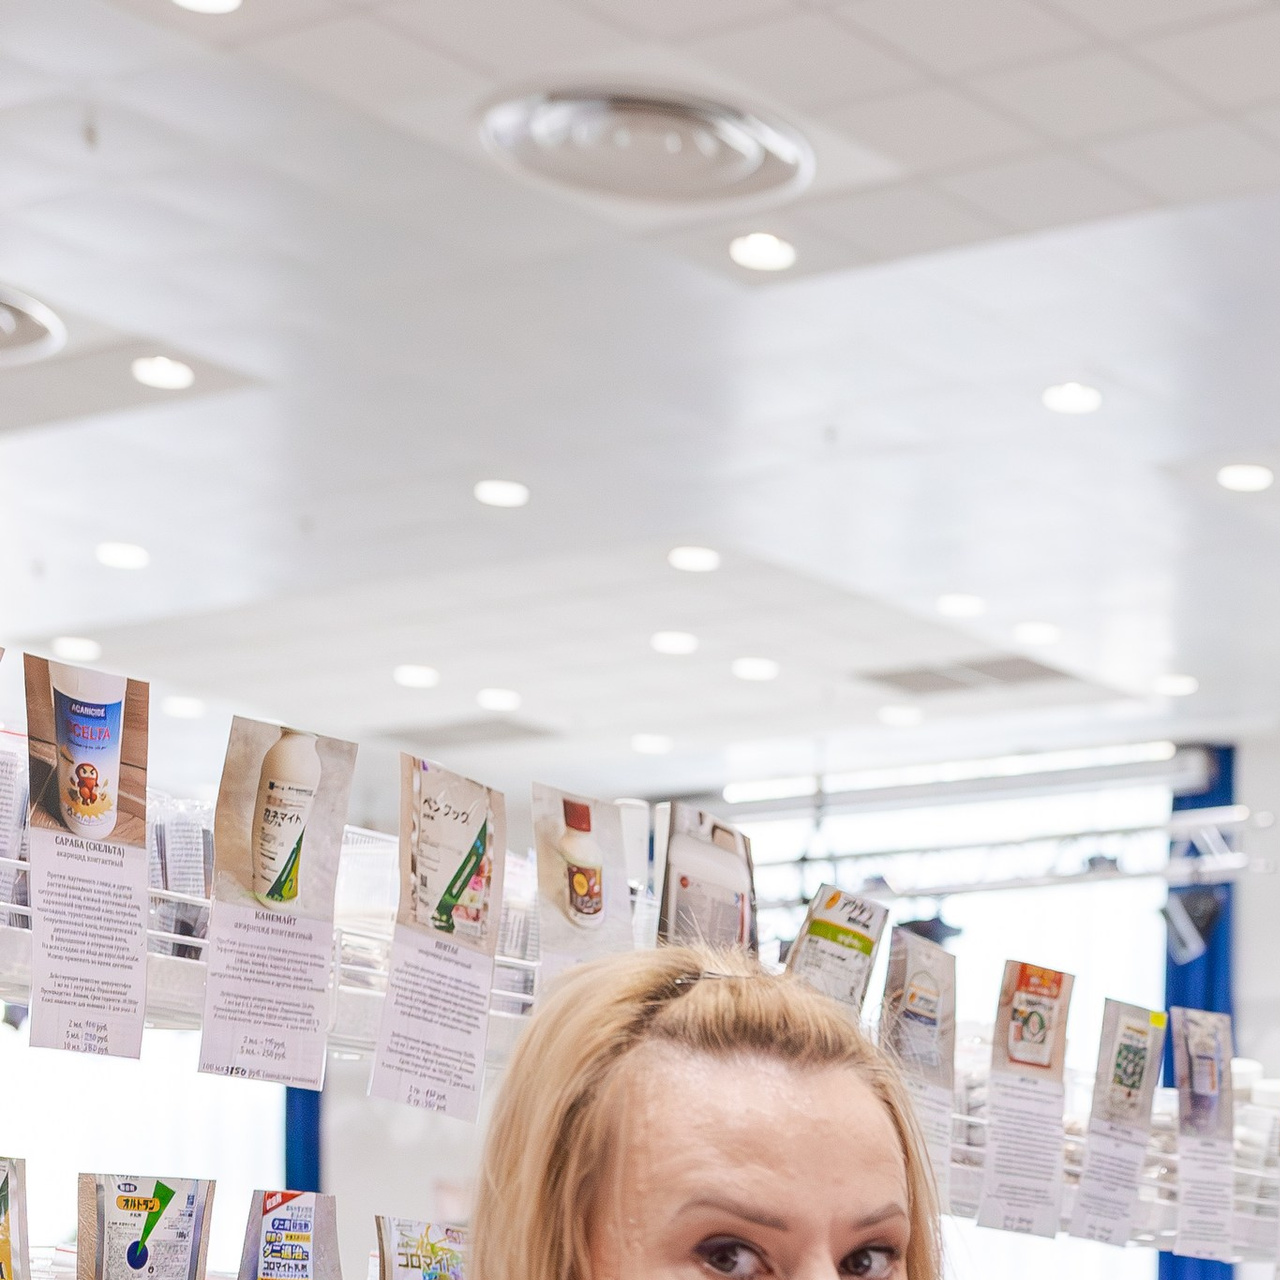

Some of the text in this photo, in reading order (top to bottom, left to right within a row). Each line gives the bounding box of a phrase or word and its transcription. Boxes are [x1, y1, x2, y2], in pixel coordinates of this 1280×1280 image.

[54, 835, 124, 857] САРАБА (СКЕЛЬТА)
[254, 910, 297, 926] КАНЕМАЙТ
